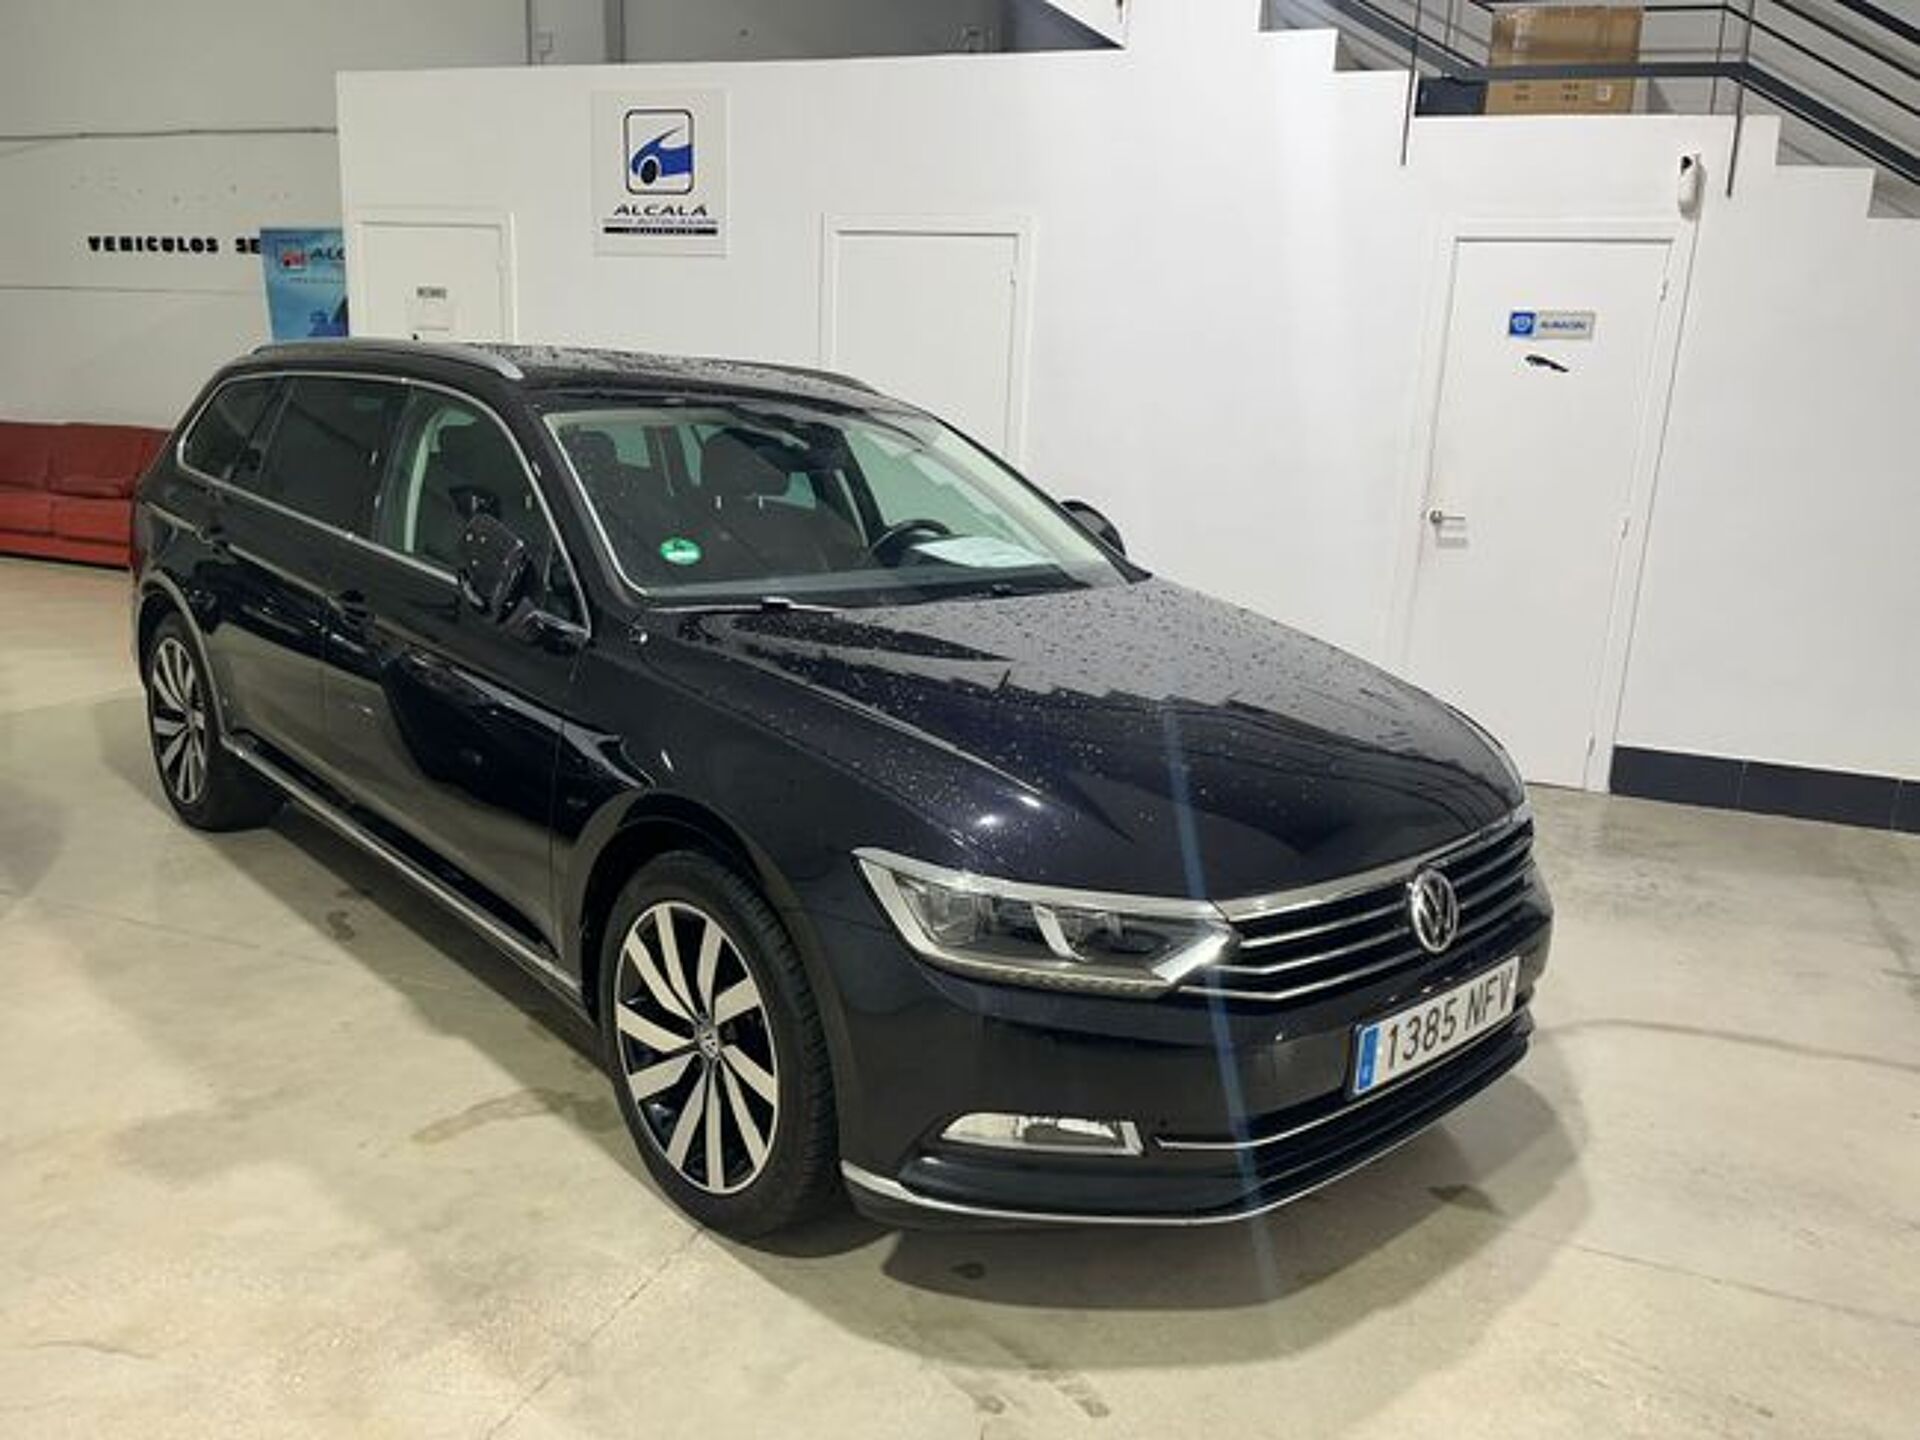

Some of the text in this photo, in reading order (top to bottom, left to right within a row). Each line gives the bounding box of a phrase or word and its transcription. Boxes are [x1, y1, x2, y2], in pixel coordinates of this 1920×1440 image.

[87, 236, 219, 253] VEHICULOS
[1387, 967, 1514, 1070] 1385 NFV
